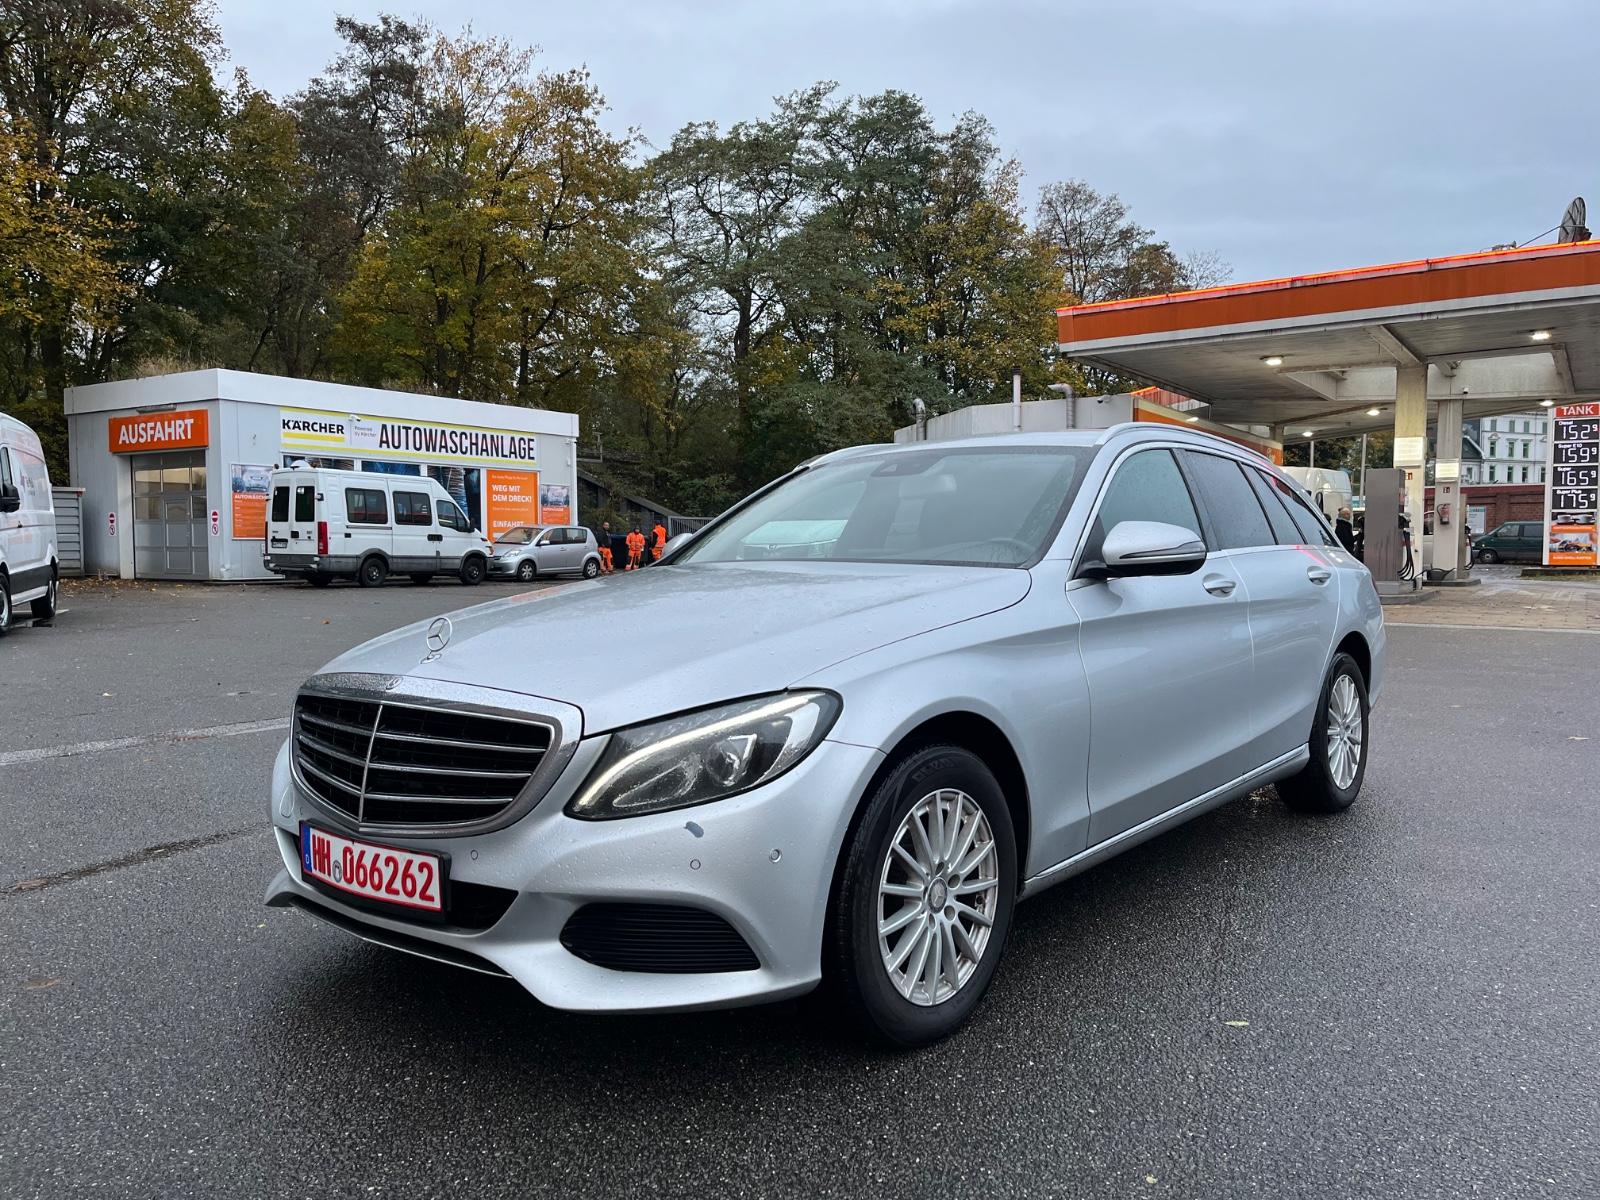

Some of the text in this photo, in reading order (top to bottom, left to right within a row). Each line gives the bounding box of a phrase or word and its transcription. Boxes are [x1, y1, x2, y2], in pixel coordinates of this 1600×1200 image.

[1561, 405, 1594, 416] TANK
[118, 418, 195, 445] AUSFAHRT
[281, 418, 345, 435] KÄRCHER
[378, 423, 536, 461] AUTOWASCHANLAGE
[491, 484, 521, 493] WEG MIT
[492, 494, 532, 503] DEM DRECK!
[493, 520, 524, 528] EINFAHRT
[311, 833, 436, 903] HH 066262
